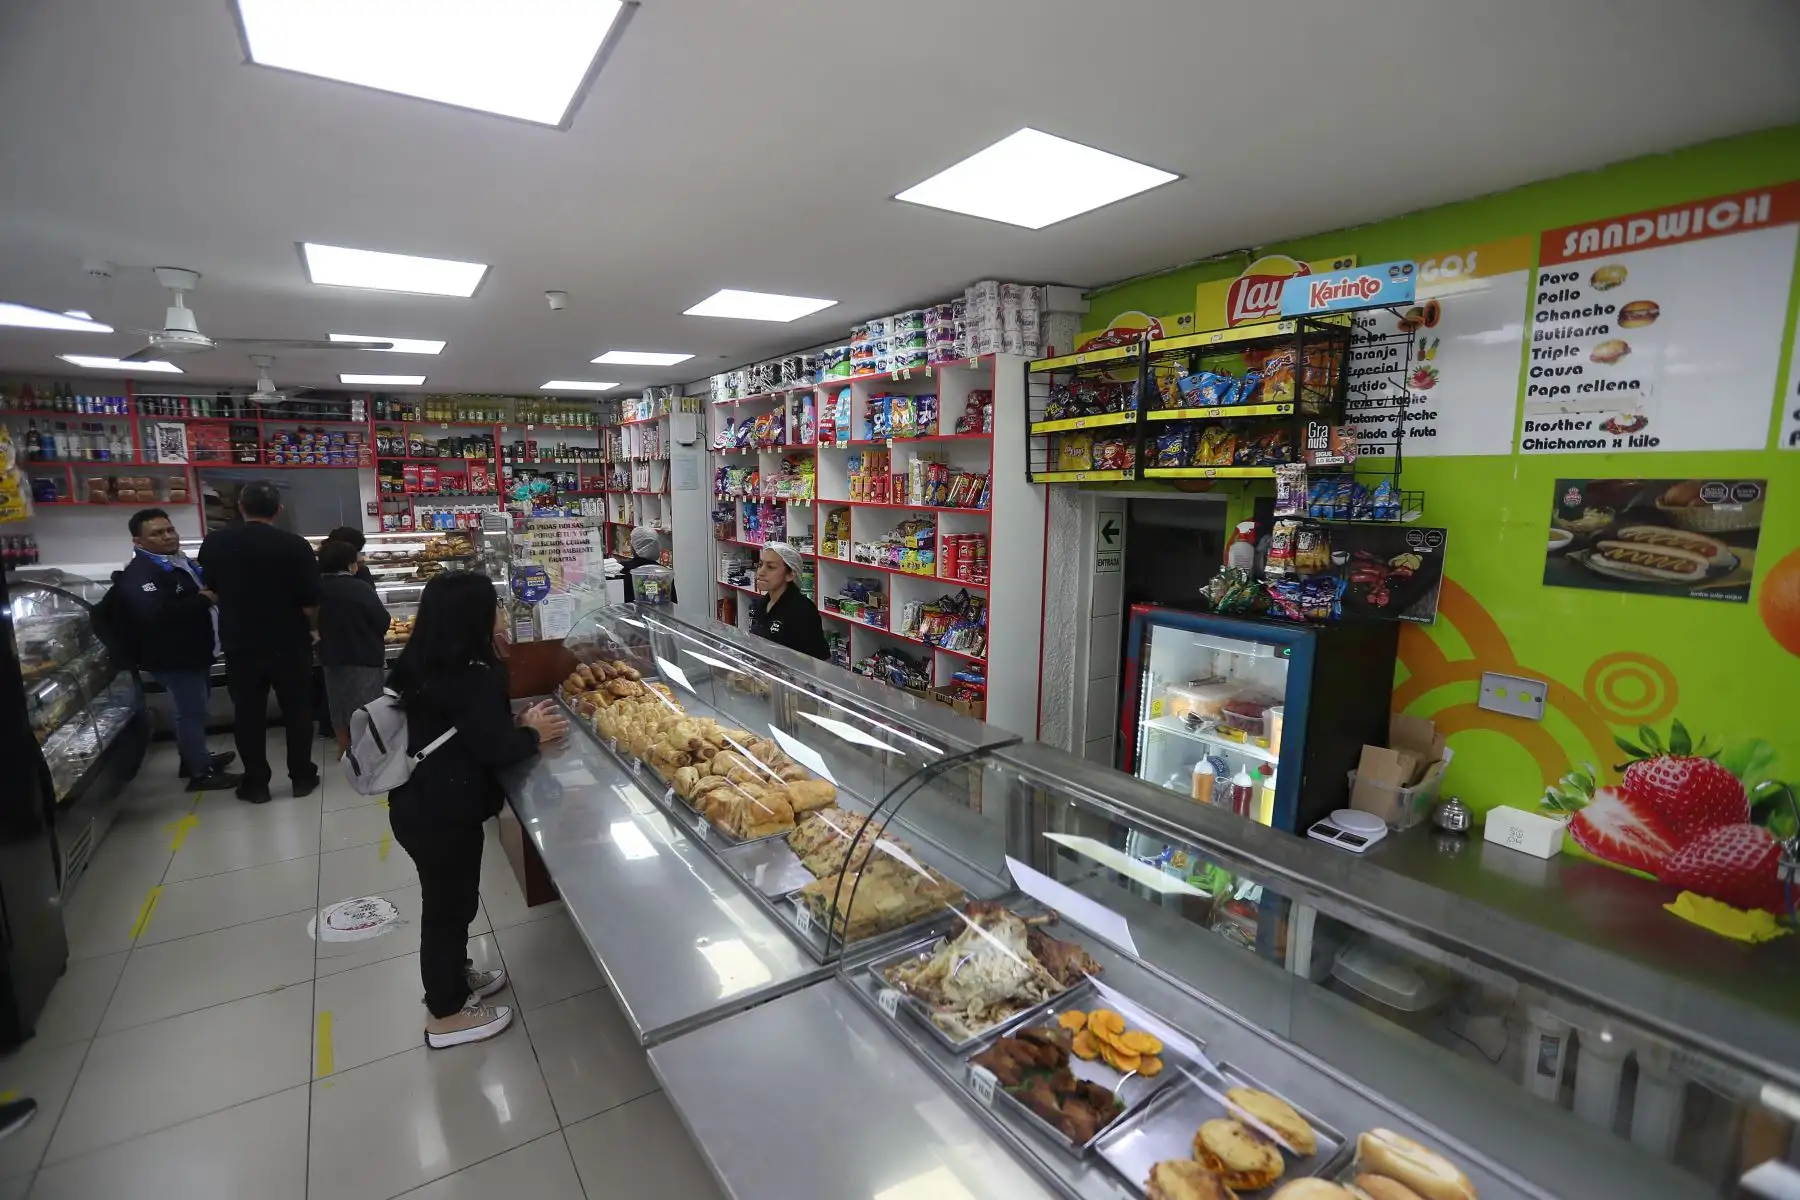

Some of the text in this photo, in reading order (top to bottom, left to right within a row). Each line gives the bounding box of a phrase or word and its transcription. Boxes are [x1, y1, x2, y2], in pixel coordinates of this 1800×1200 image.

[1563, 194, 1771, 257] SANDWICH
[1418, 251, 1478, 283] GOS
[1539, 270, 1580, 287] Pavo
[1309, 276, 1382, 309] Karinto
[1537, 289, 1581, 305] Pollo
[1536, 302, 1616, 323] Chancho
[1534, 324, 1610, 342] Butifarra
[1532, 345, 1581, 361] Triple
[1530, 364, 1584, 379] Causa
[1528, 378, 1641, 397] Papa rellena
[1308, 421, 1329, 438] Gra
[1410, 426, 1437, 438] fruta
[1524, 420, 1592, 433] Brosther
[1308, 437, 1328, 449] nuts
[1522, 434, 1660, 450] Chicharron x kilo
[1315, 450, 1333, 458] SIGUE
